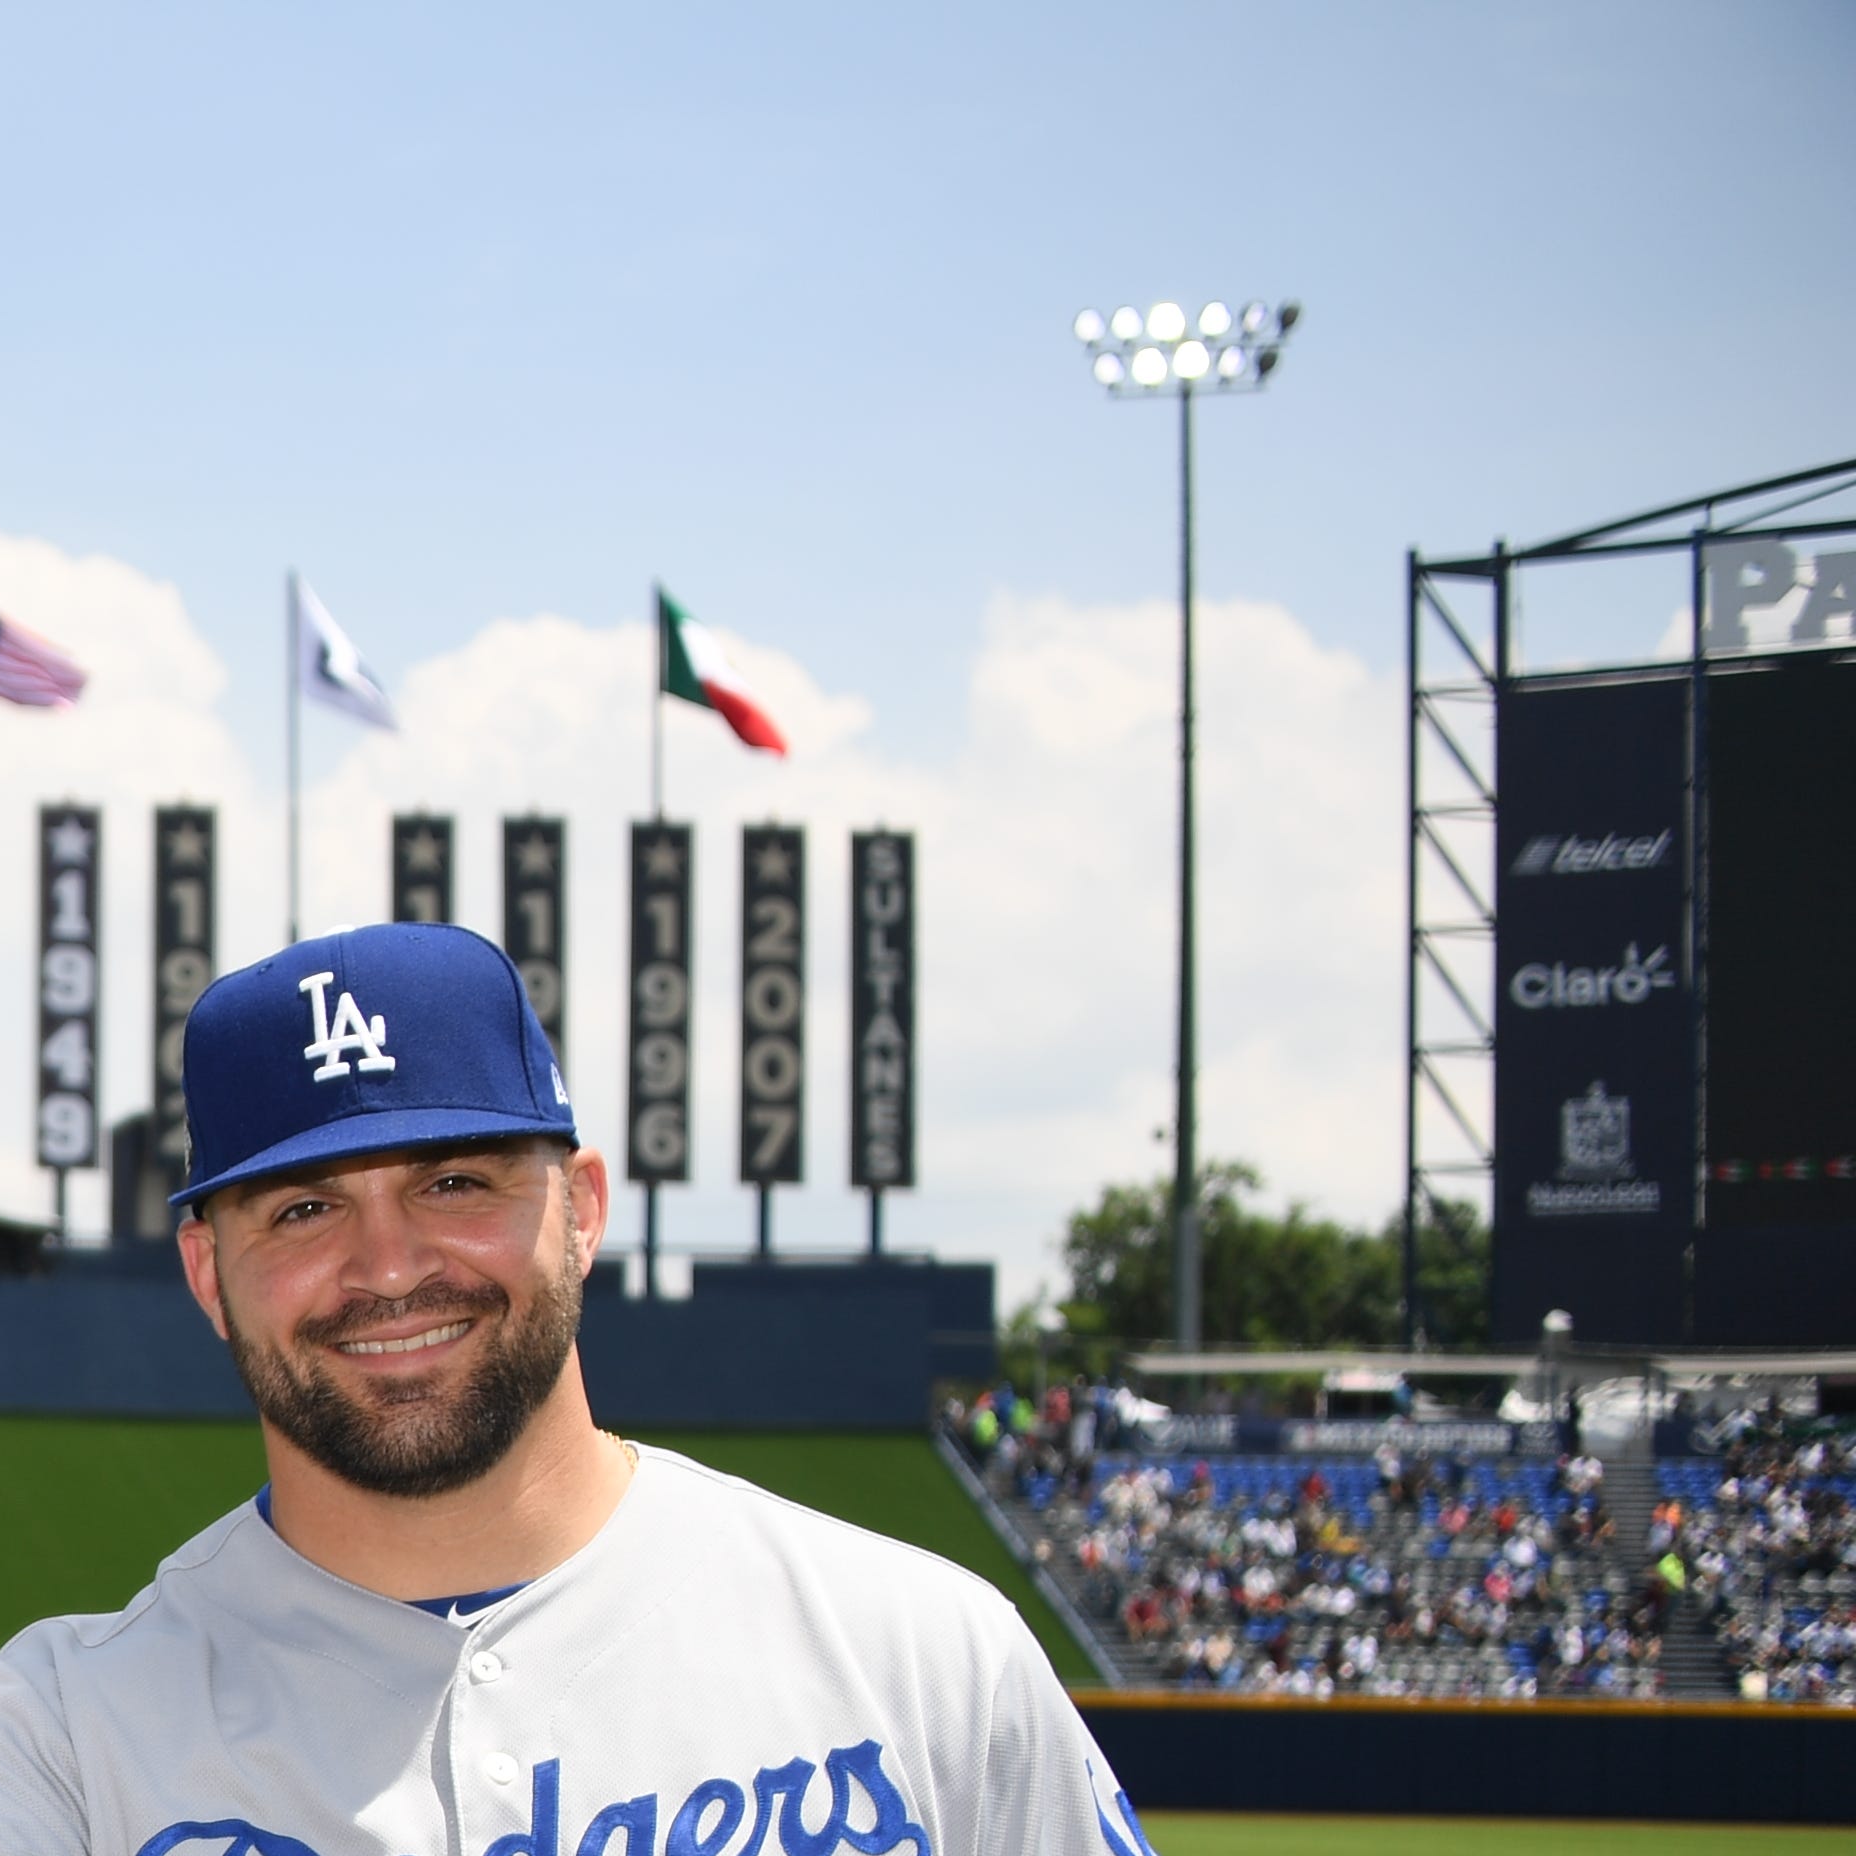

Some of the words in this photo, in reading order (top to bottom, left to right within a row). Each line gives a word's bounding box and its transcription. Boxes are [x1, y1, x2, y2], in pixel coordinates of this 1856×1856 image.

[1510, 955, 1654, 1008] Claro
[1552, 828, 1673, 874] telcel
[41, 868, 96, 1164] 1949
[299, 972, 396, 1082] LA
[635, 892, 689, 1168] 1996
[748, 897, 799, 1168] 2007
[862, 836, 907, 1180] SULTANES
